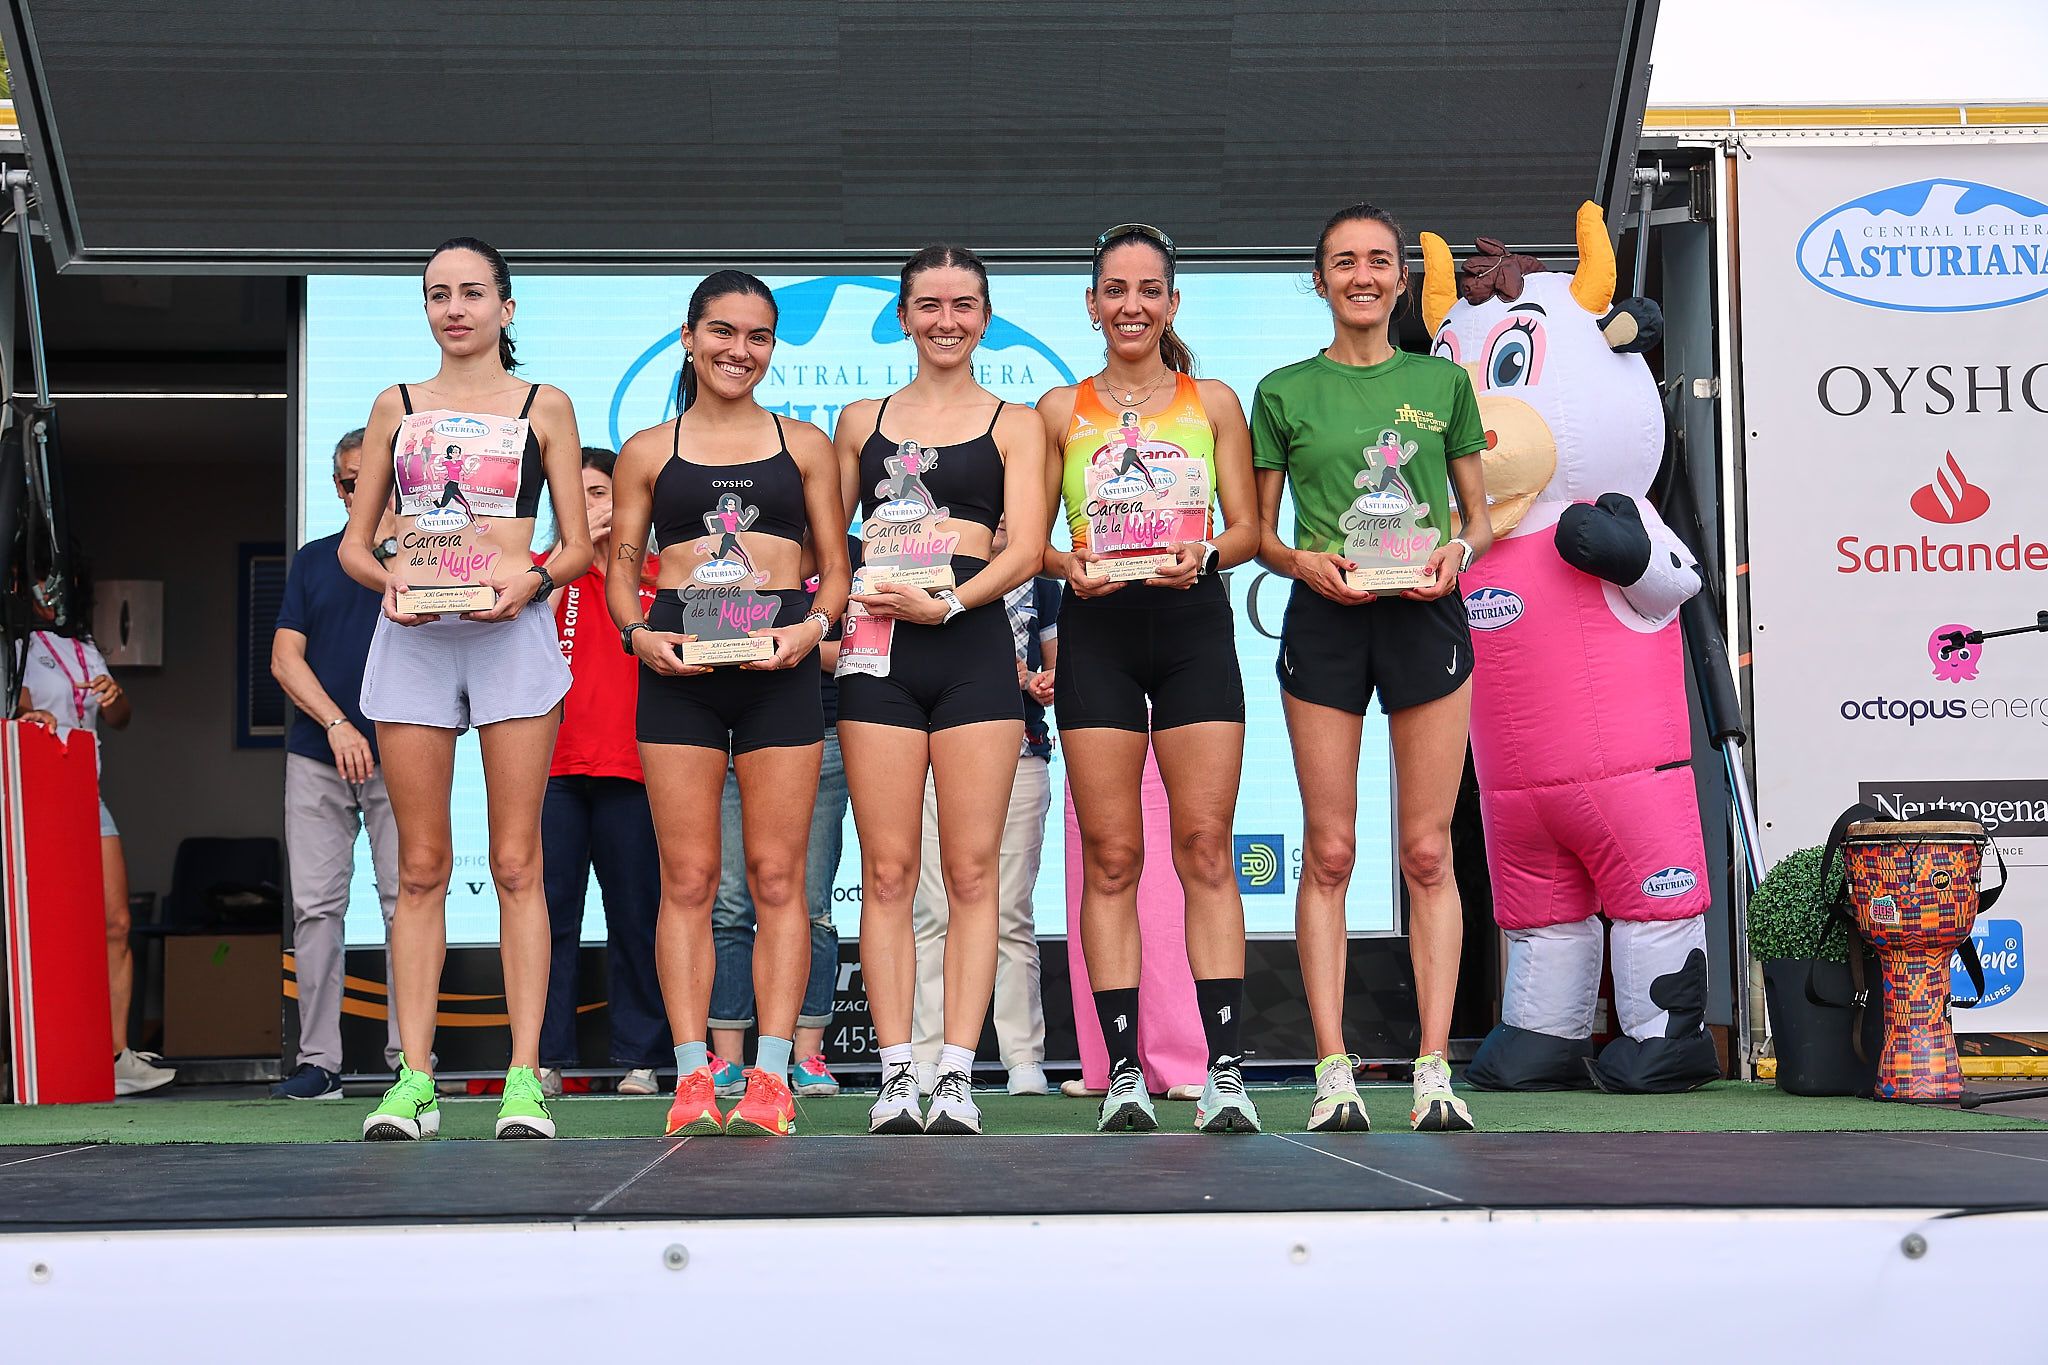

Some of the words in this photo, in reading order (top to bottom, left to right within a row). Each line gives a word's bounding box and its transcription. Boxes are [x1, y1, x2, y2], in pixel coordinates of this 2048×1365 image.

[1863, 225, 1953, 237] CENTRAL
[438, 424, 486, 434] ASTURIANA
[476, 484, 504, 494] VALENCIA
[1102, 485, 1144, 496] ASTURIANA
[881, 508, 922, 516] ASTURIANA
[1086, 500, 1144, 516] Carrera
[1362, 500, 1404, 509] ASTURIANA
[420, 518, 464, 527] ASTURIANA
[866, 522, 922, 538] Carrera
[1094, 519, 1108, 534] de
[1112, 518, 1121, 532] la
[1122, 512, 1180, 547] Mujer
[1344, 515, 1401, 530] Carrera
[403, 532, 462, 548] Carrera
[1352, 534, 1366, 548] de
[1369, 532, 1378, 546] la
[1378, 528, 1435, 562] Mujer
[874, 541, 886, 554] de
[890, 540, 899, 553] la
[900, 532, 956, 566] Mujer
[1836, 534, 2048, 573] Santande
[410, 551, 424, 566] de
[428, 550, 438, 566] la
[436, 545, 497, 582] Mujer
[700, 570, 742, 578] ASTURIANA
[683, 584, 741, 600] Carrera
[564, 584, 580, 626] correr
[691, 603, 704, 618] de
[708, 603, 718, 616] la
[716, 596, 777, 632] Mujer
[564, 628, 576, 637] a
[1840, 696, 1967, 726] octopus
[1647, 878, 1694, 892] ASTURIANA
[1984, 984, 2011, 1003] ALPES
